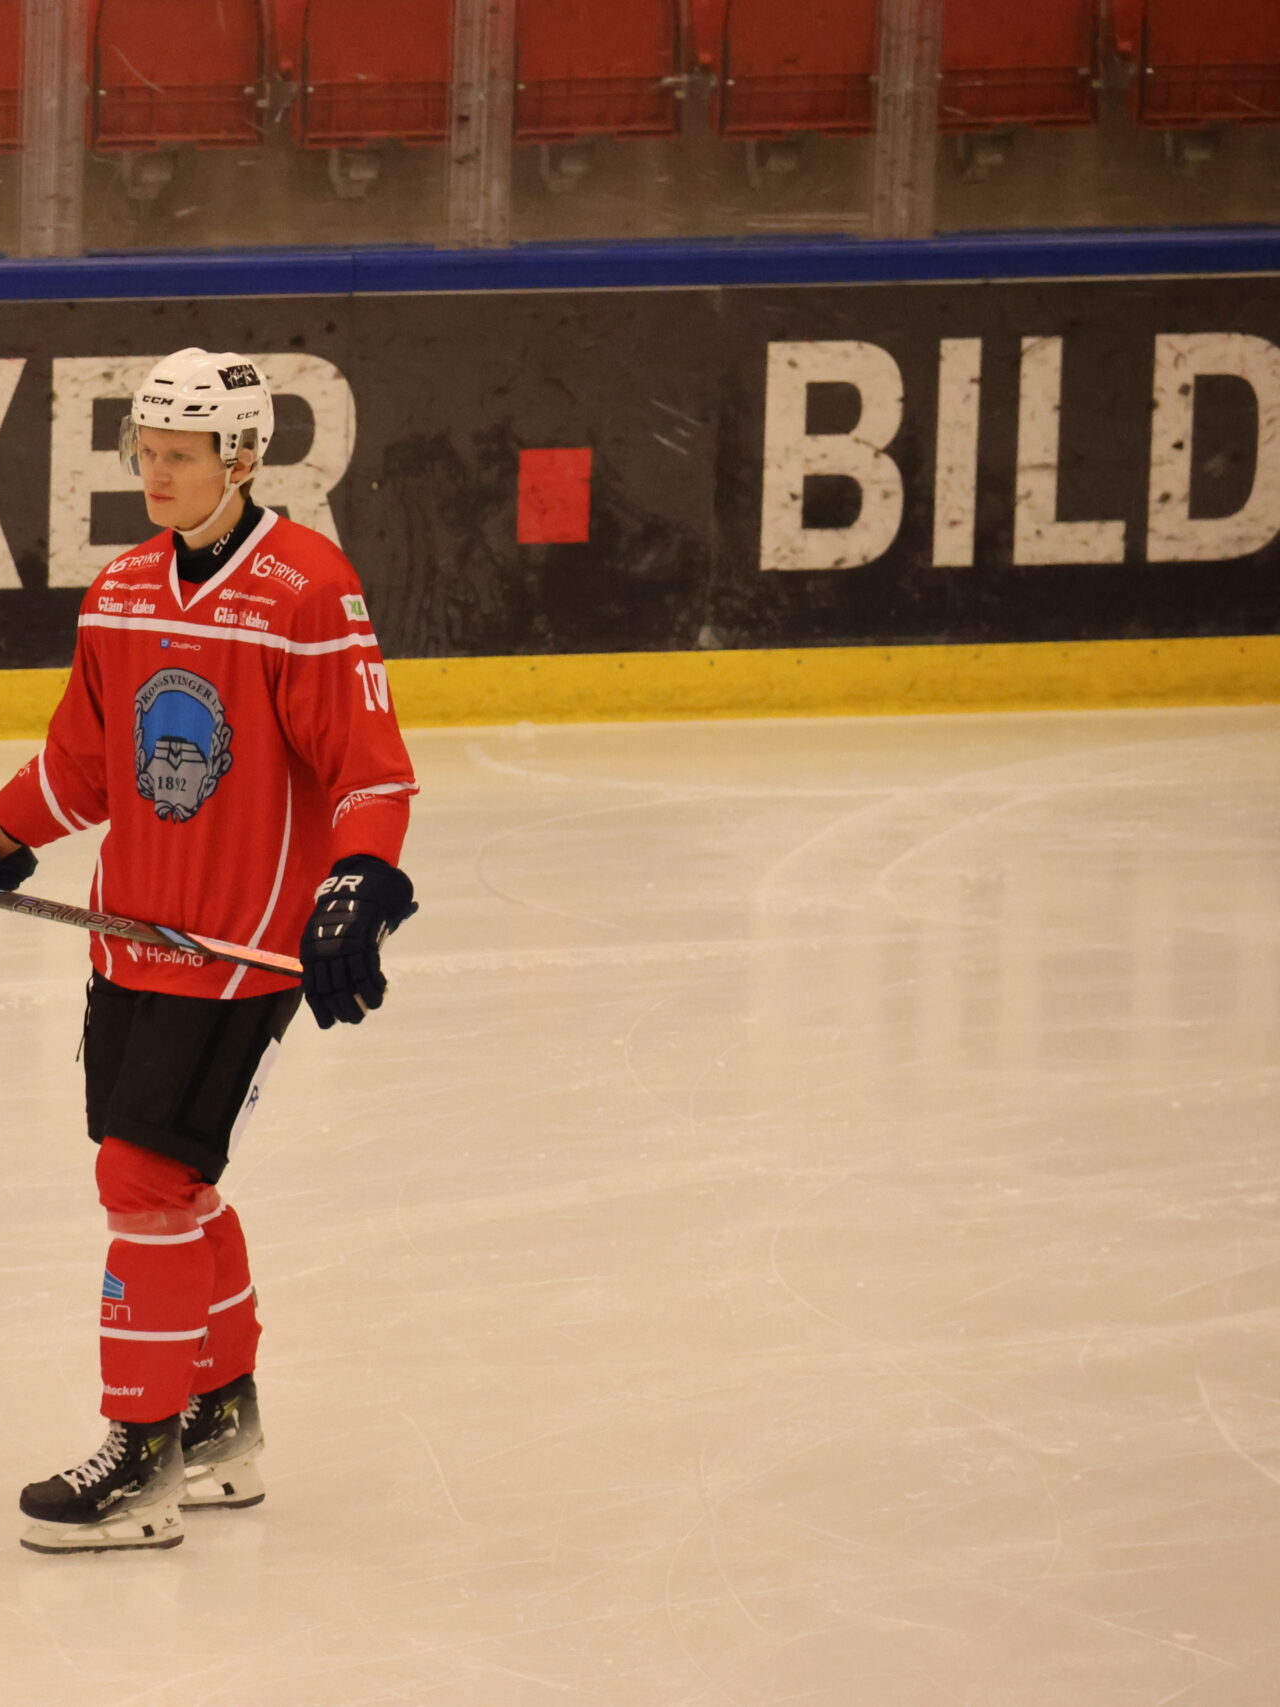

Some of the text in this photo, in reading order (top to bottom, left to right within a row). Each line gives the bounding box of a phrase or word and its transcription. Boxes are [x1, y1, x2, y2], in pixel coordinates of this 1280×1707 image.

[142, 395, 174, 406] CCM
[237, 410, 260, 420] CCM
[760, 332, 1280, 571] BILD
[271, 561, 309, 591] TRYKK
[158, 776, 187, 792] 1892
